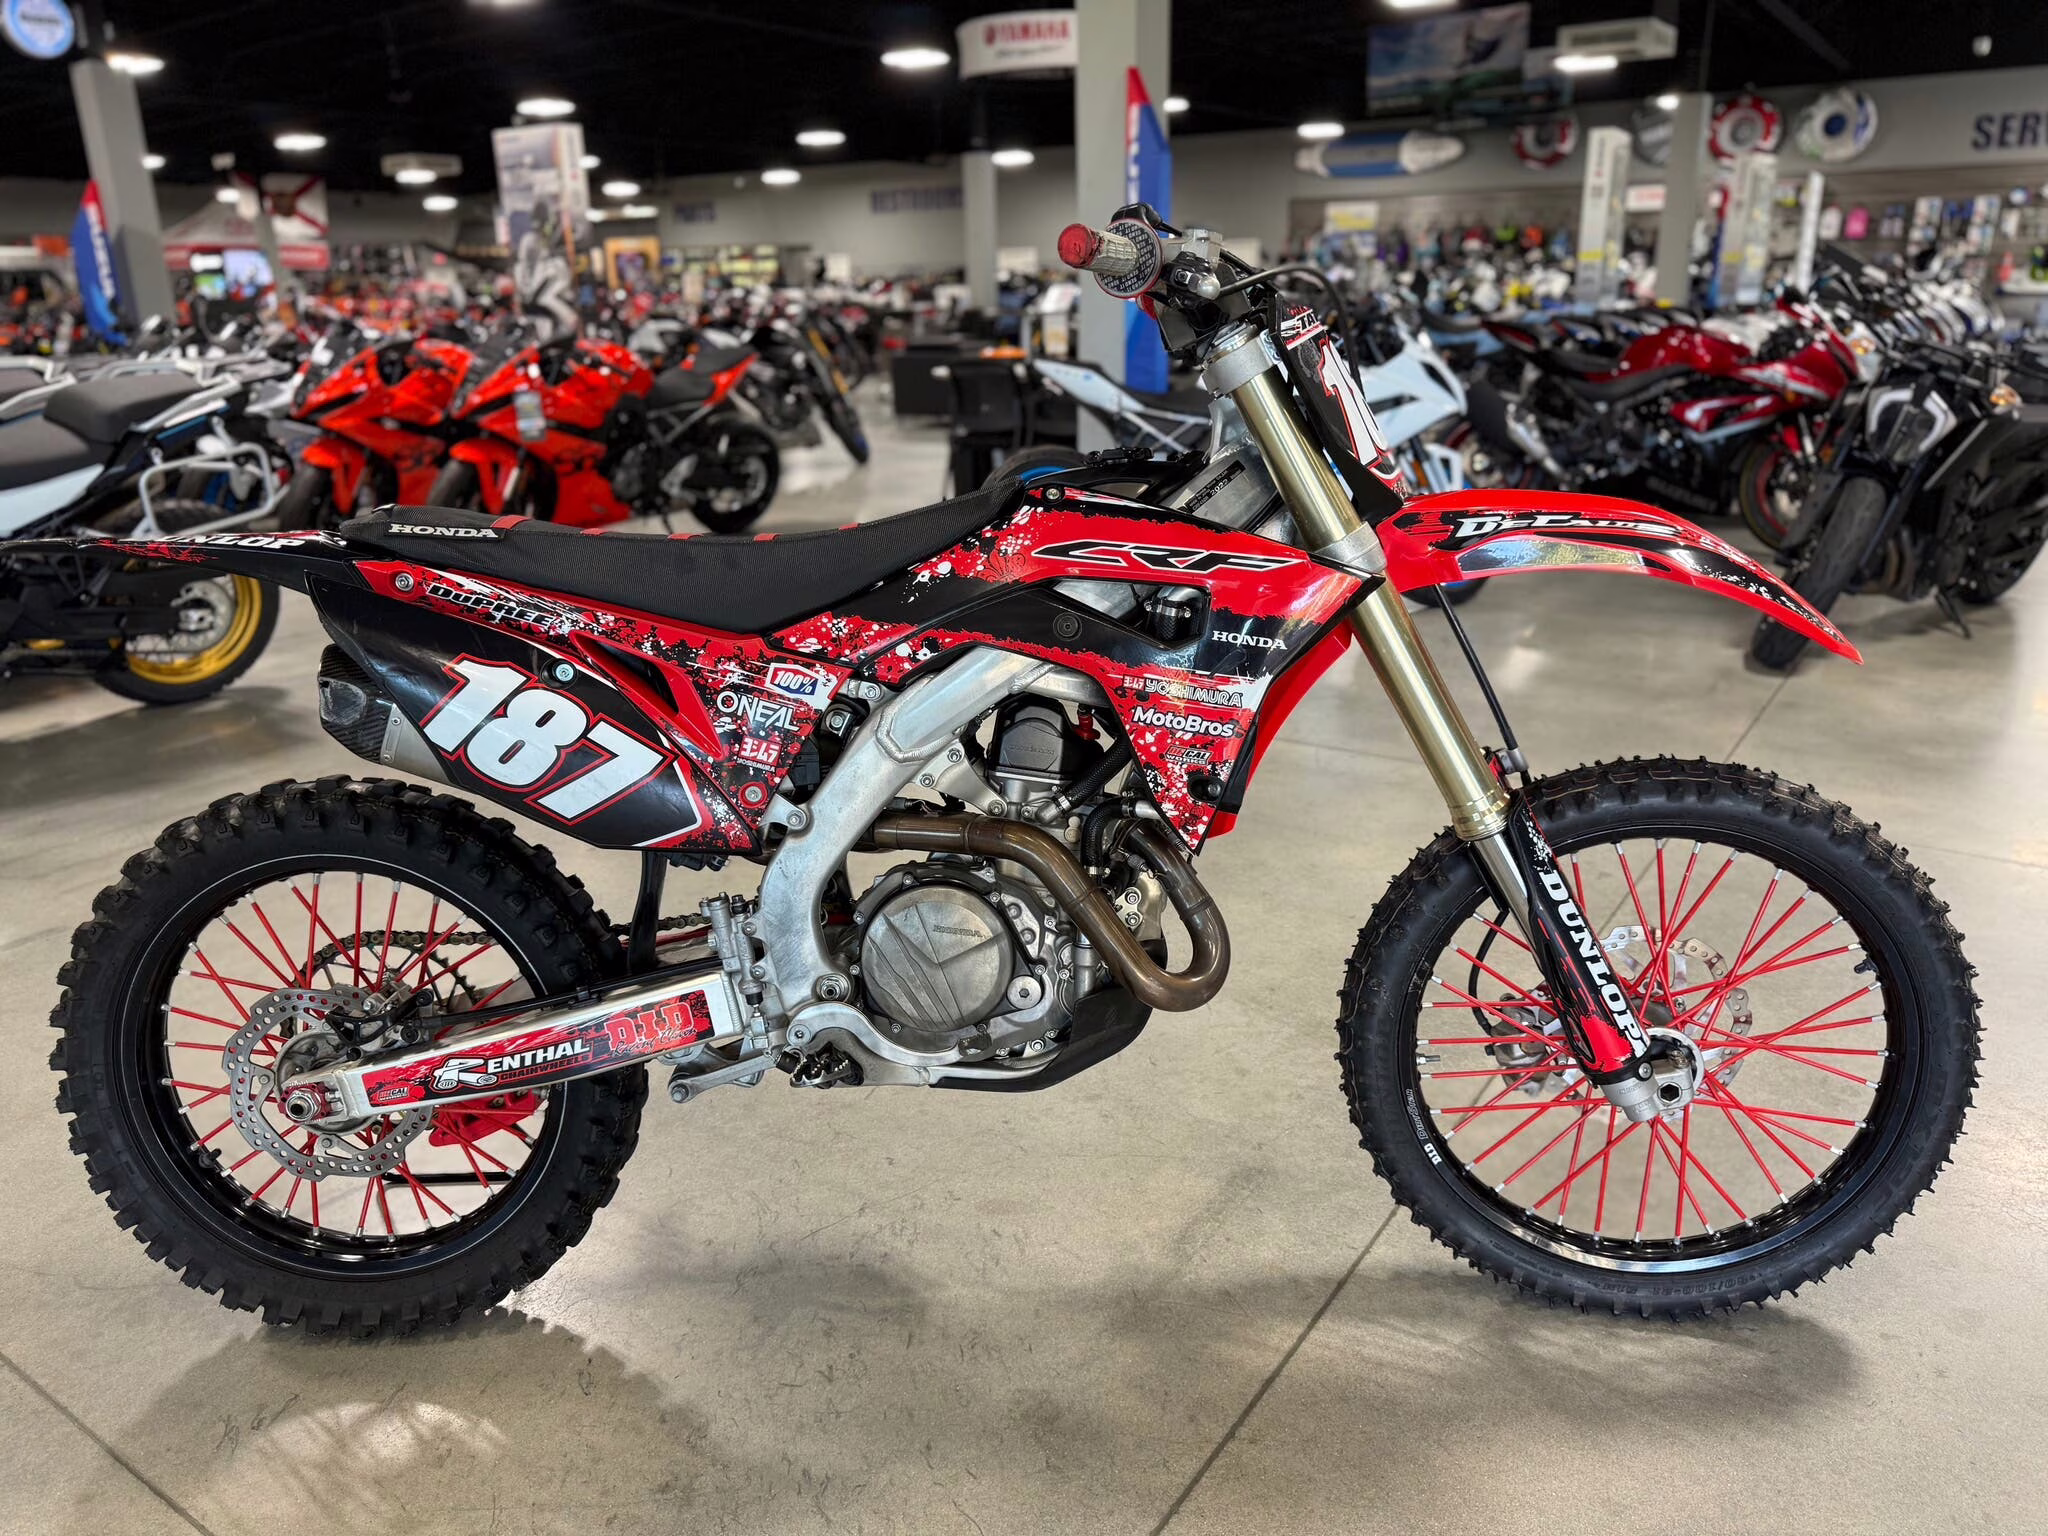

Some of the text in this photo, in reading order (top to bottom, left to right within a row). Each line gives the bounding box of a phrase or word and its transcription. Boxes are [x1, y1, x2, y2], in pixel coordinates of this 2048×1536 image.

[1971, 111, 2048, 152] SER
[1210, 478, 1228, 497] 2022
[388, 523, 498, 538] HONDA
[1032, 539, 1308, 574] CRF
[1212, 630, 1287, 650] HONDA
[773, 670, 816, 694] 100%
[1145, 679, 1243, 707] YOSHIMURA
[1133, 707, 1235, 738] MotoBros
[420, 656, 668, 822] 187
[933, 925, 983, 938] HONDA
[1539, 870, 1651, 1058] DUNLOP
[433, 1039, 590, 1089] RENTHAL
[501, 1054, 590, 1080] CHAINWHEELS
